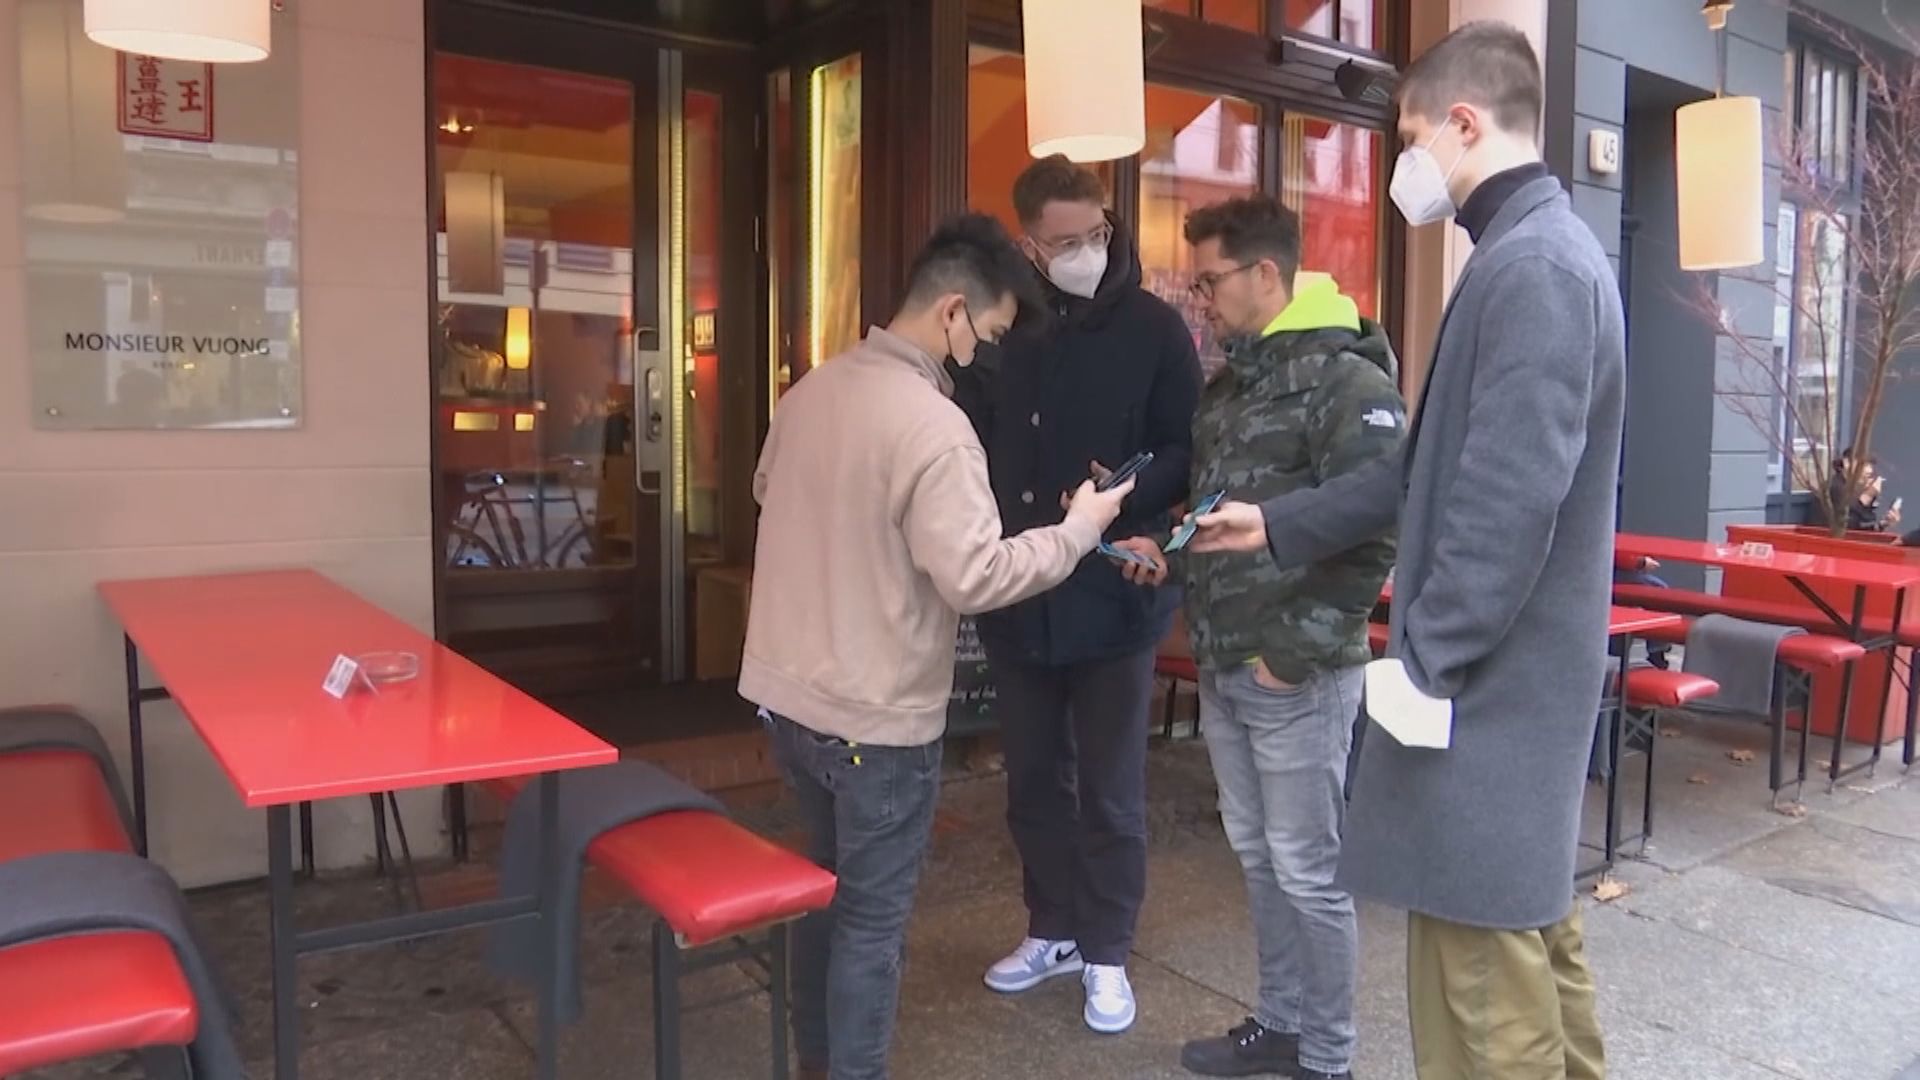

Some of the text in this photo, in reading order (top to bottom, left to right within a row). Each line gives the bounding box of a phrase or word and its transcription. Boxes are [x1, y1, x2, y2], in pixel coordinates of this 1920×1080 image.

[177, 79, 202, 112] 王
[1602, 136, 1616, 164] 45
[65, 332, 271, 355] MONSIEUR VUONG
